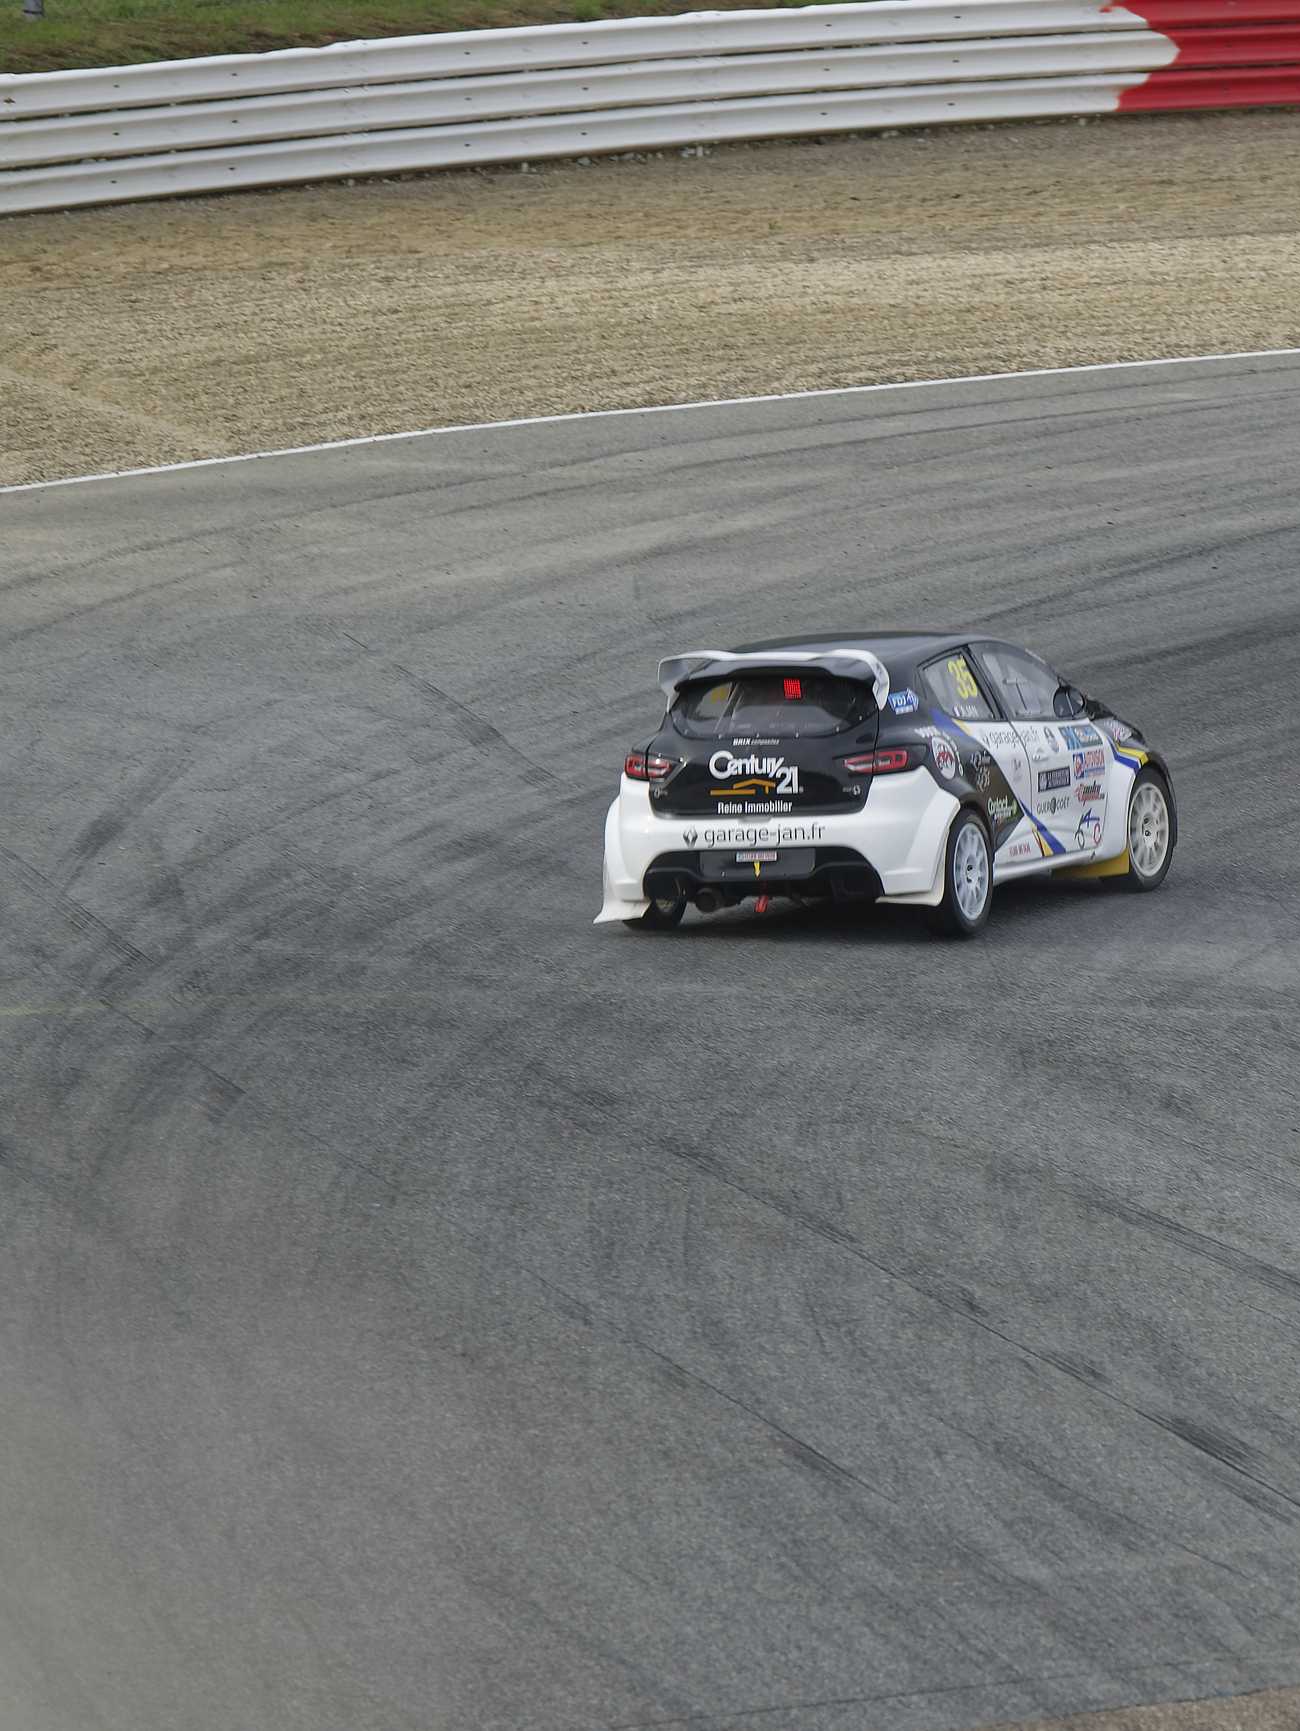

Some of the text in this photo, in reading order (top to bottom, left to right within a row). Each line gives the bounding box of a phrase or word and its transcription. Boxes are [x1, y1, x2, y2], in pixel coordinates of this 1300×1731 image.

[947, 656, 978, 699] 35
[709, 750, 799, 794] Century 21
[718, 801, 793, 814] Reine Immobilier
[704, 823, 825, 848] garage-jan.fr
